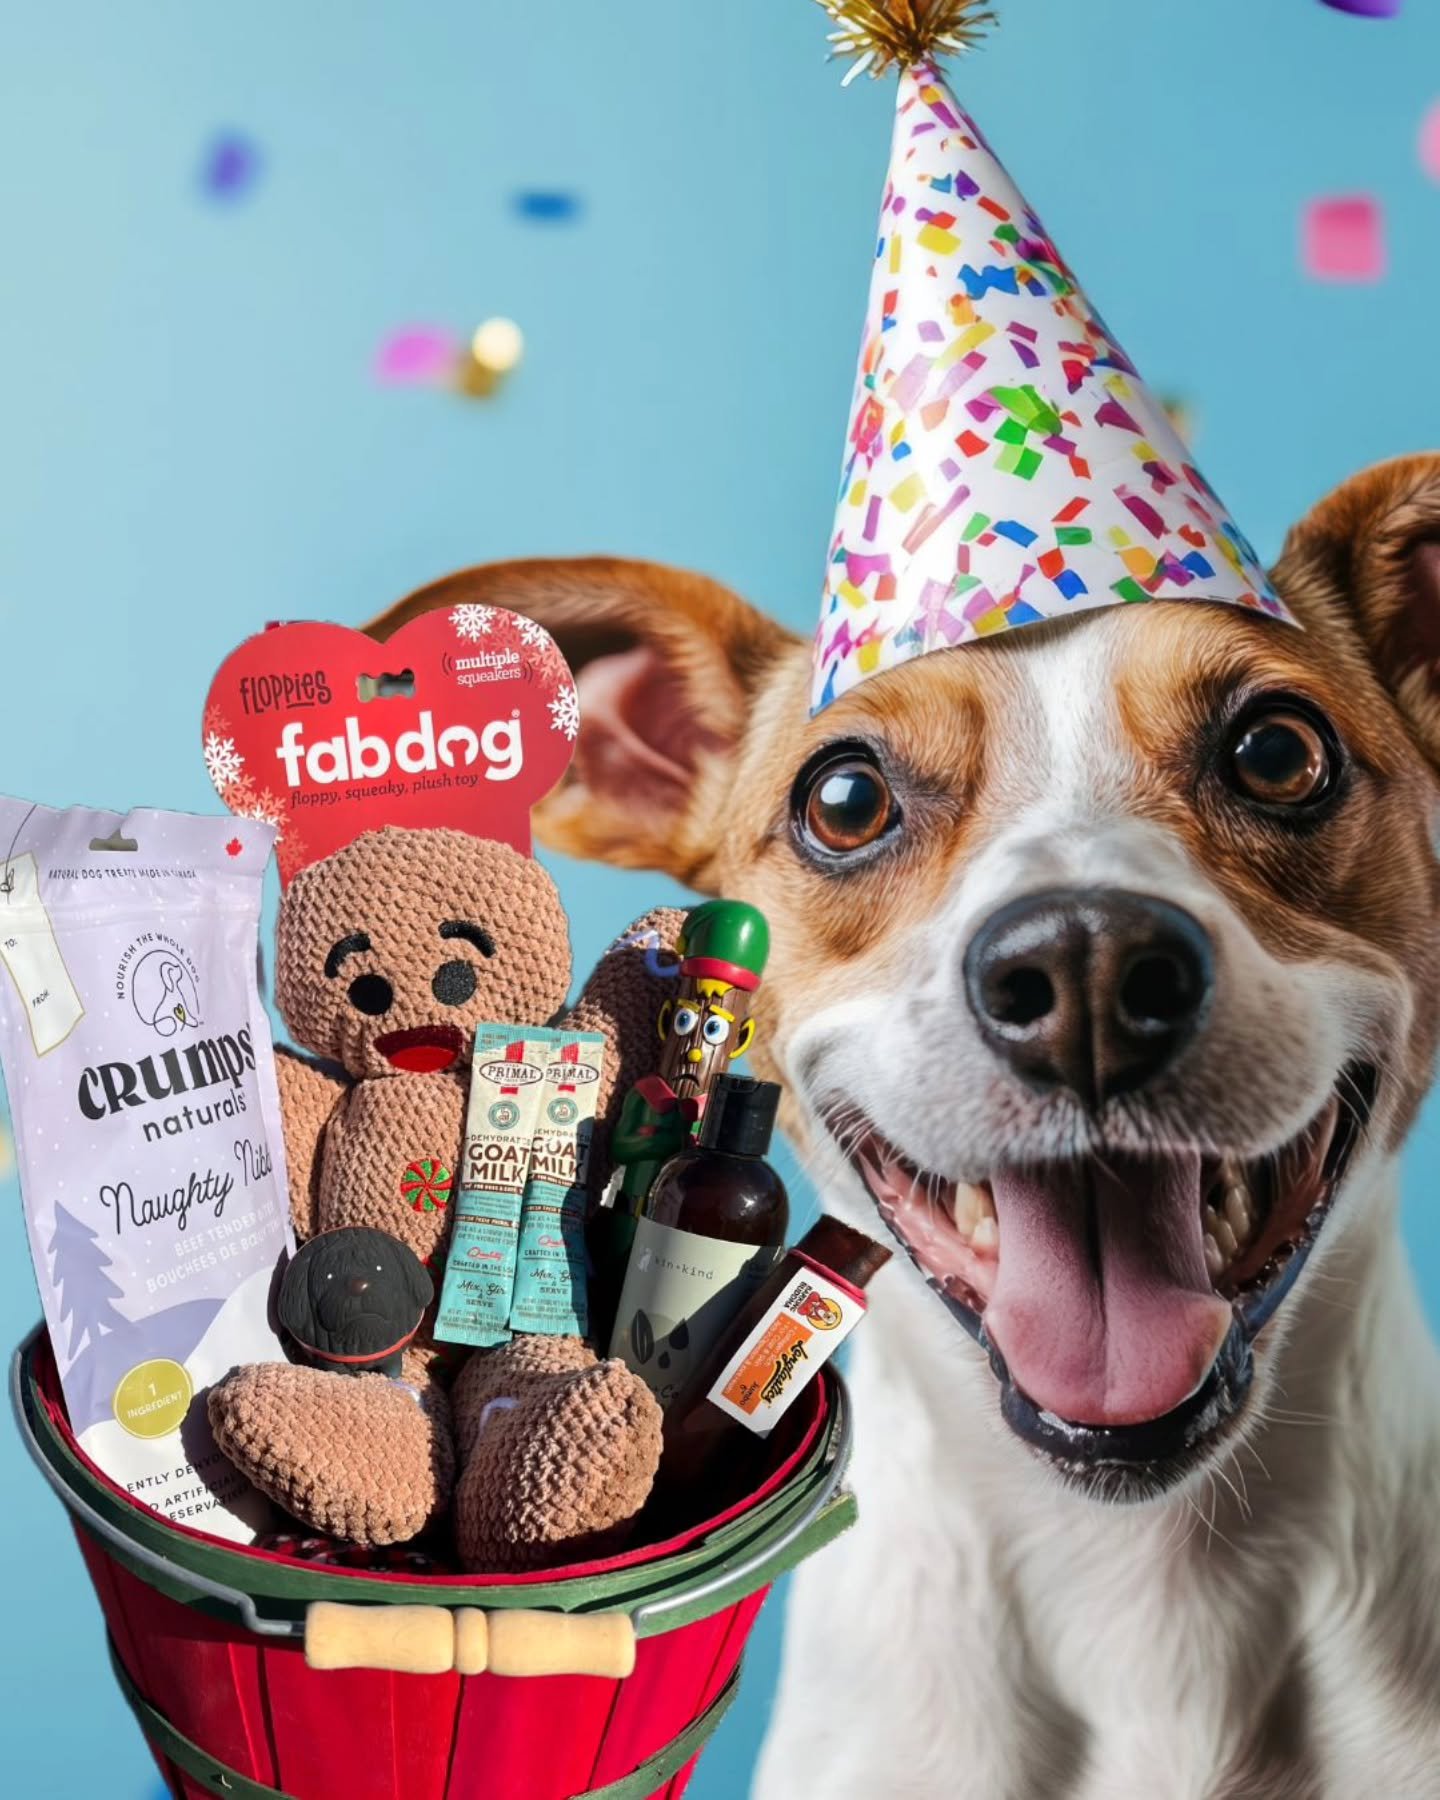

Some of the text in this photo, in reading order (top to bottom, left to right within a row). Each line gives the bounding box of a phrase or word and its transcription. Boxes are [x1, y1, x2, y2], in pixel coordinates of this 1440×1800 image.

[455, 651, 520, 670] multiple
[457, 668, 521, 686] squeakers
[412, 774, 452, 794] plush
[454, 773, 479, 789] toy
[48, 869, 79, 880] NATURAL
[81, 869, 102, 880] DOG
[116, 946, 136, 1000] NOURISH
[136, 932, 153, 947] THE
[156, 932, 185, 955] WHOLE
[487, 1065, 537, 1080] PRIMAL
[546, 1066, 593, 1080] PRIMAL
[143, 1088, 246, 1142] naturals
[468, 1143, 530, 1165] GOAT
[532, 1137, 588, 1162] GOAT
[470, 1162, 525, 1182] MILK
[532, 1154, 581, 1178] MILK
[100, 1169, 234, 1234] Naughty
[174, 1236, 205, 1257] BEEF
[539, 1285, 567, 1296] SERVE
[784, 1281, 807, 1309] BUDDHA
[761, 1340, 809, 1403] Longlastics
[147, 1382, 158, 1397] 1
[127, 1390, 184, 1419] INGREDIENT
[127, 1472, 170, 1493] ENTLY
